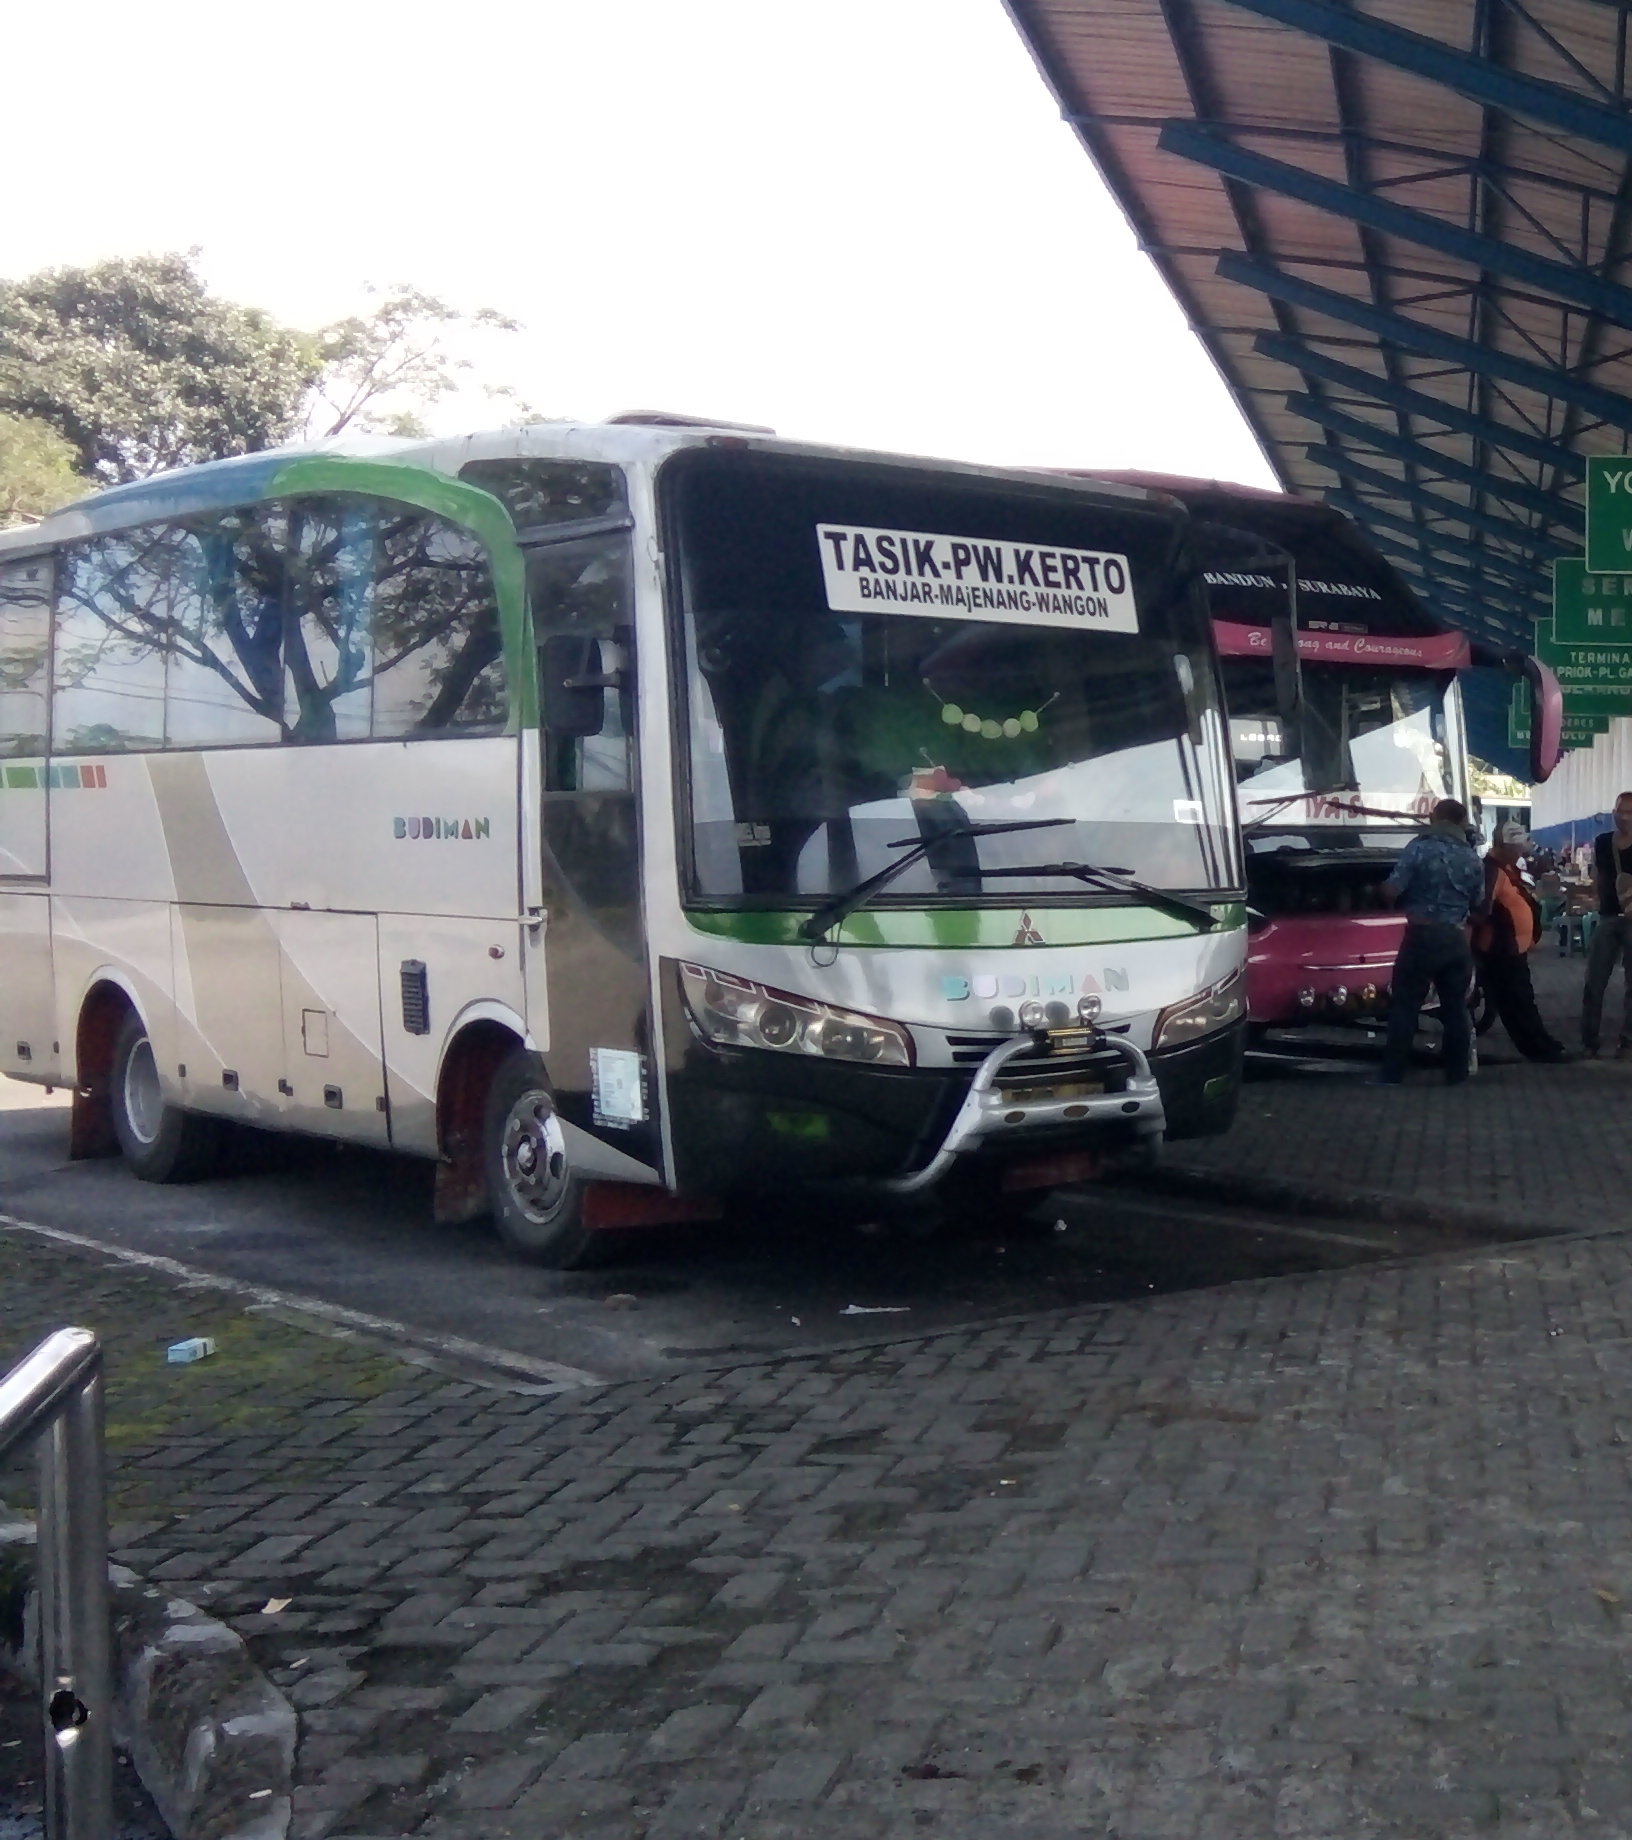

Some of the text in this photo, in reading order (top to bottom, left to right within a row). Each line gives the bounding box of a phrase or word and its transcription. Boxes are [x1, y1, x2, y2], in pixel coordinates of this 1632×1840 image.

[823, 530, 1126, 595] TASIK-PW.KERTO
[1298, 578, 1382, 601] SURABAYA
[1247, 631, 1268, 647] Be
[1325, 637, 1350, 652] and
[1353, 636, 1423, 659] Courageous
[393, 816, 491, 840] BUDIMAN
[942, 967, 1130, 1001] BUDIMAN
